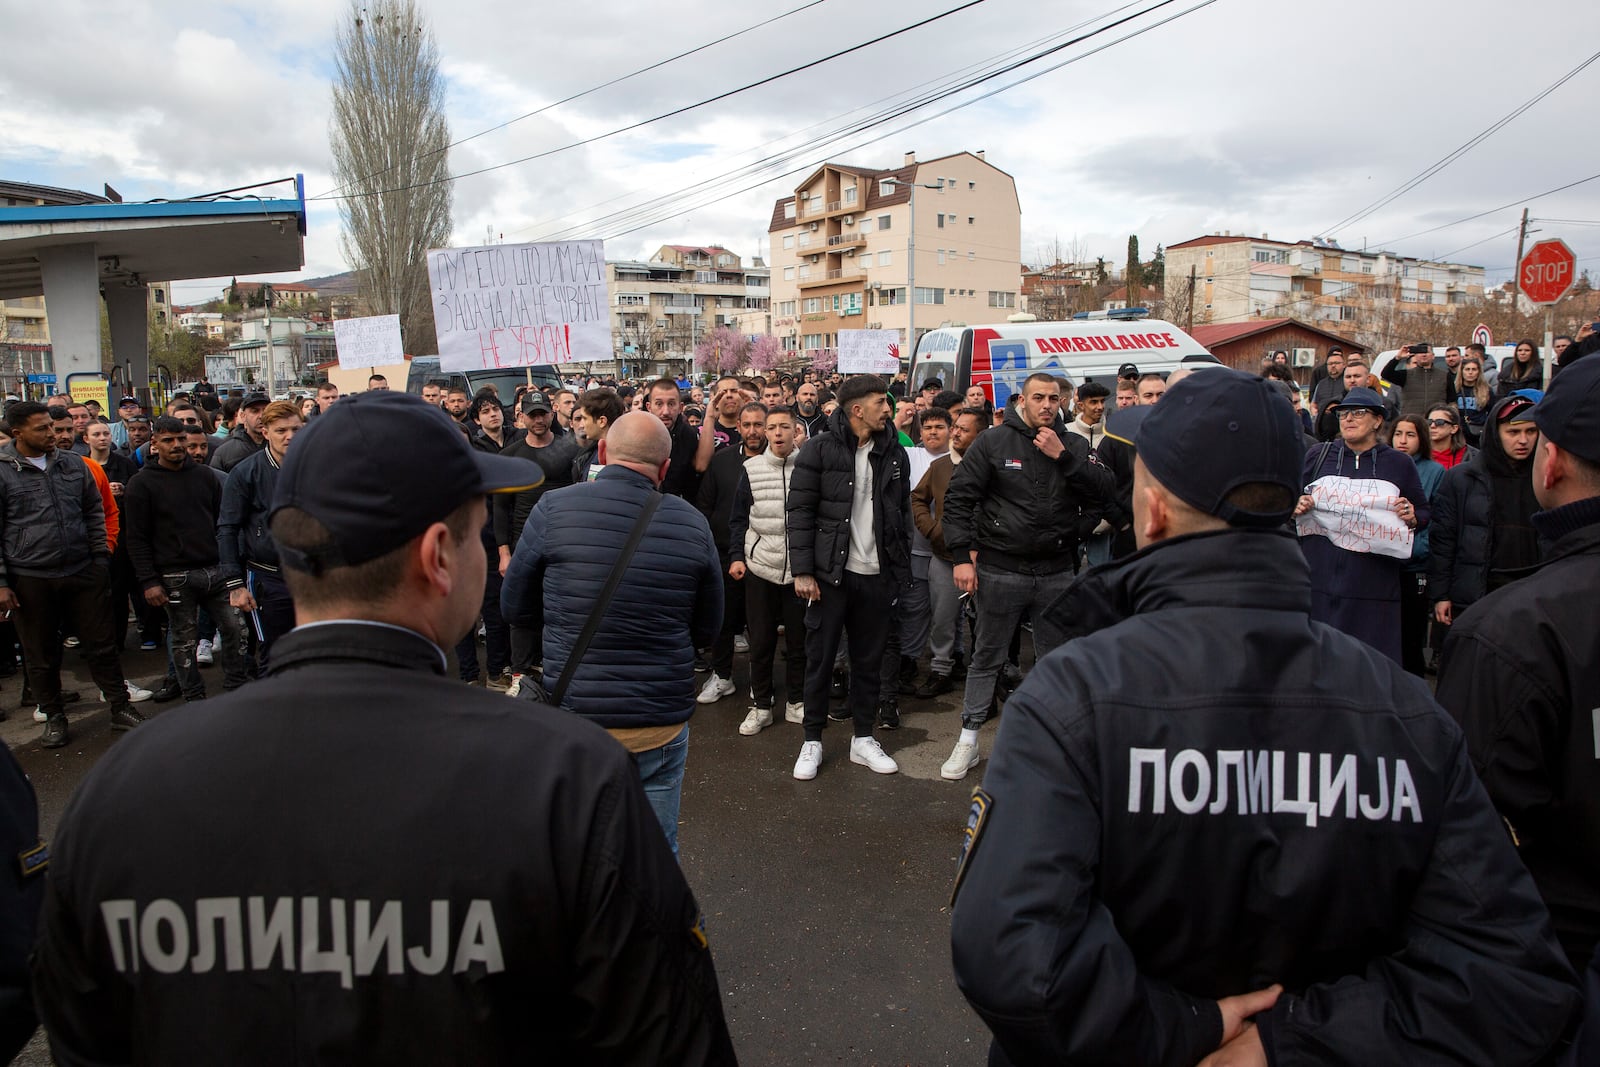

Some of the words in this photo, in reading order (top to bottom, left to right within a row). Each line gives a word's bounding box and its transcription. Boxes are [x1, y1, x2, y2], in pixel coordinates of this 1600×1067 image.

[547, 242, 602, 283] ИМАА
[1524, 261, 1568, 284] STOP
[439, 290, 507, 333] ЗАДАЧА
[508, 288, 532, 329] ДА
[553, 284, 601, 323] ЧУВААТ
[1035, 333, 1179, 353] AMBULANCE
[1127, 747, 1423, 828] ПОЛИЦИЈА
[100, 895, 506, 990] ПОЛИЦИЈА
